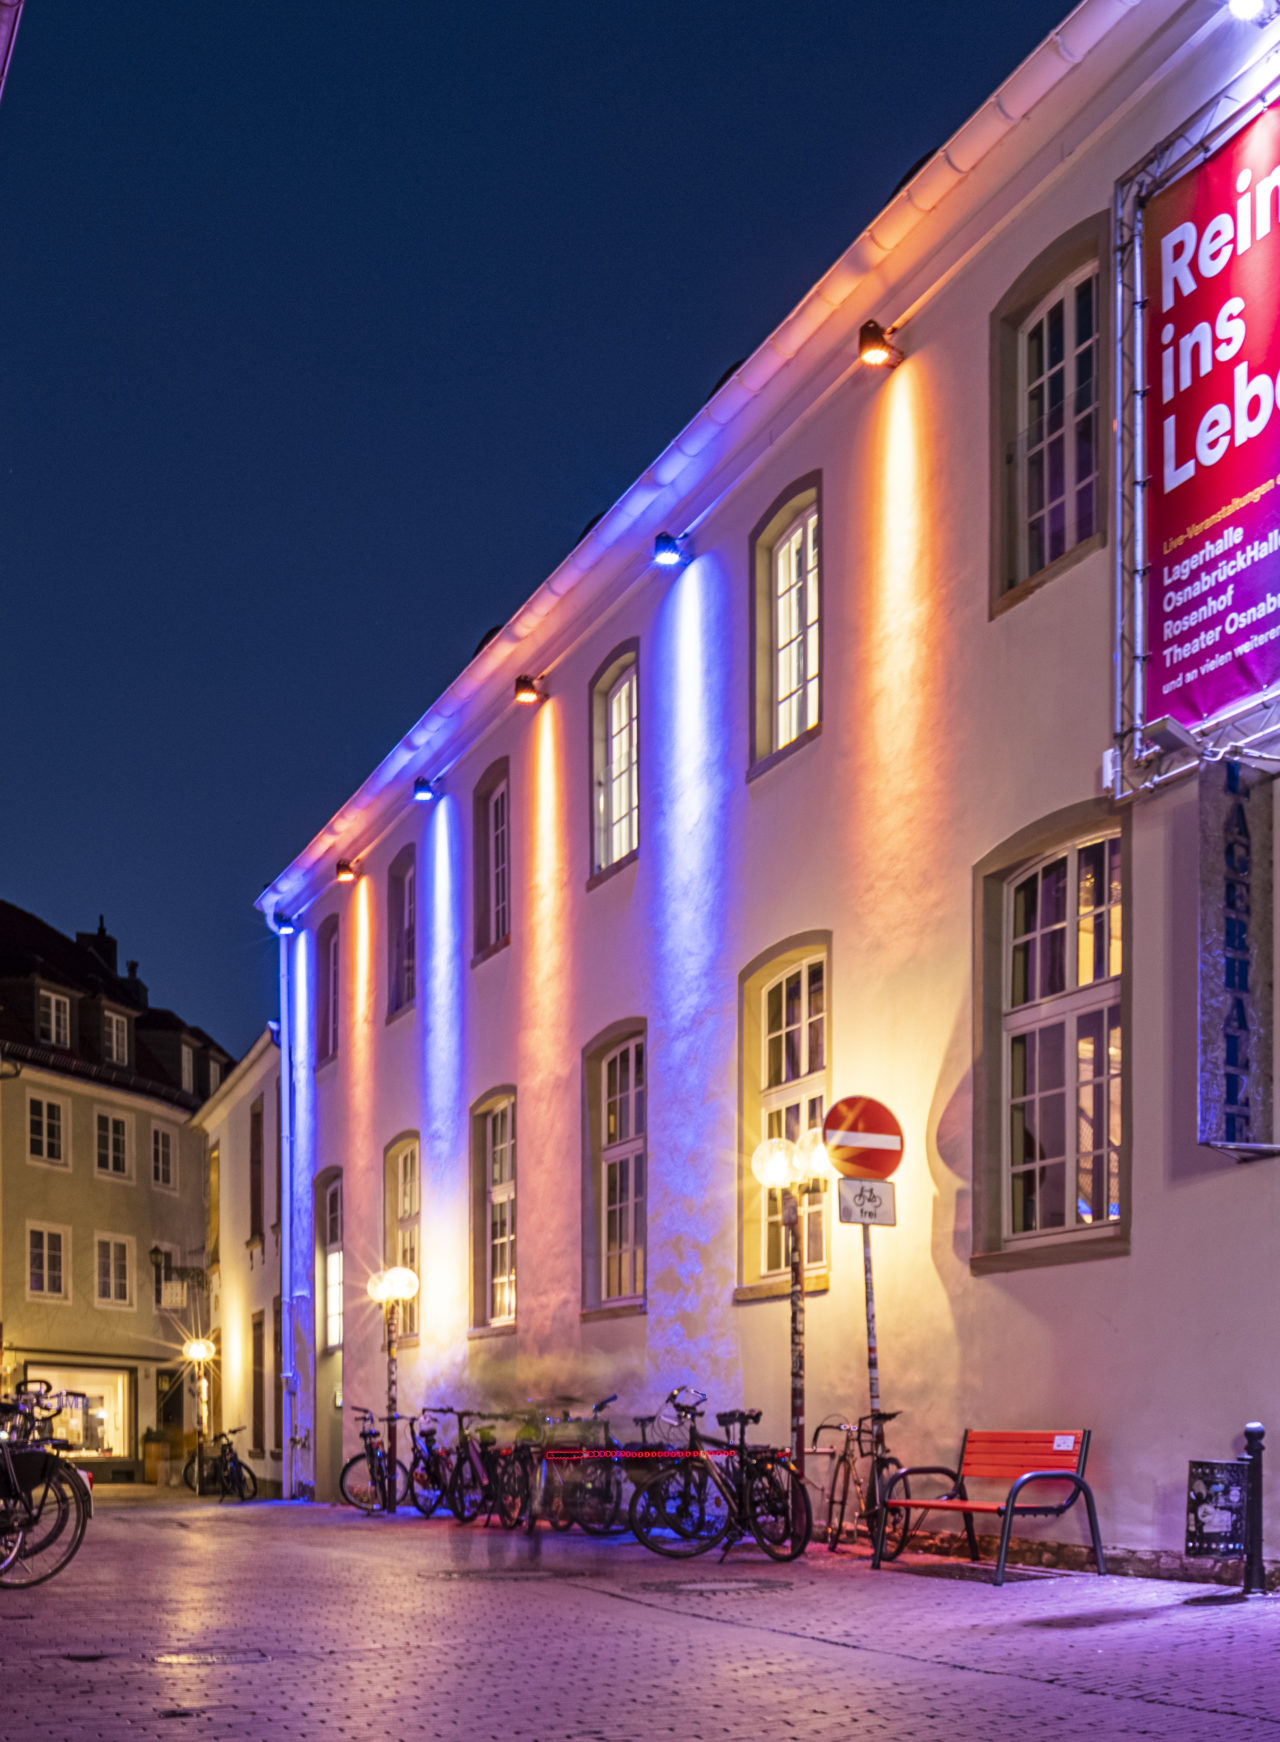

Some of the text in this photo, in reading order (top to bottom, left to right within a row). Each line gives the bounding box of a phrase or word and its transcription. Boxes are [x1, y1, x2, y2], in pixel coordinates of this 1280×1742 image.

[1161, 297, 1246, 405] ins
[1163, 526, 1244, 587] Lagerhalle
[1163, 584, 1234, 642] Rosenhof
[1163, 625, 1223, 668] Theater
[1162, 673, 1183, 695] und
[1185, 668, 1199, 684] an
[1200, 650, 1232, 675] vielen
[860, 1208, 877, 1219] frei
